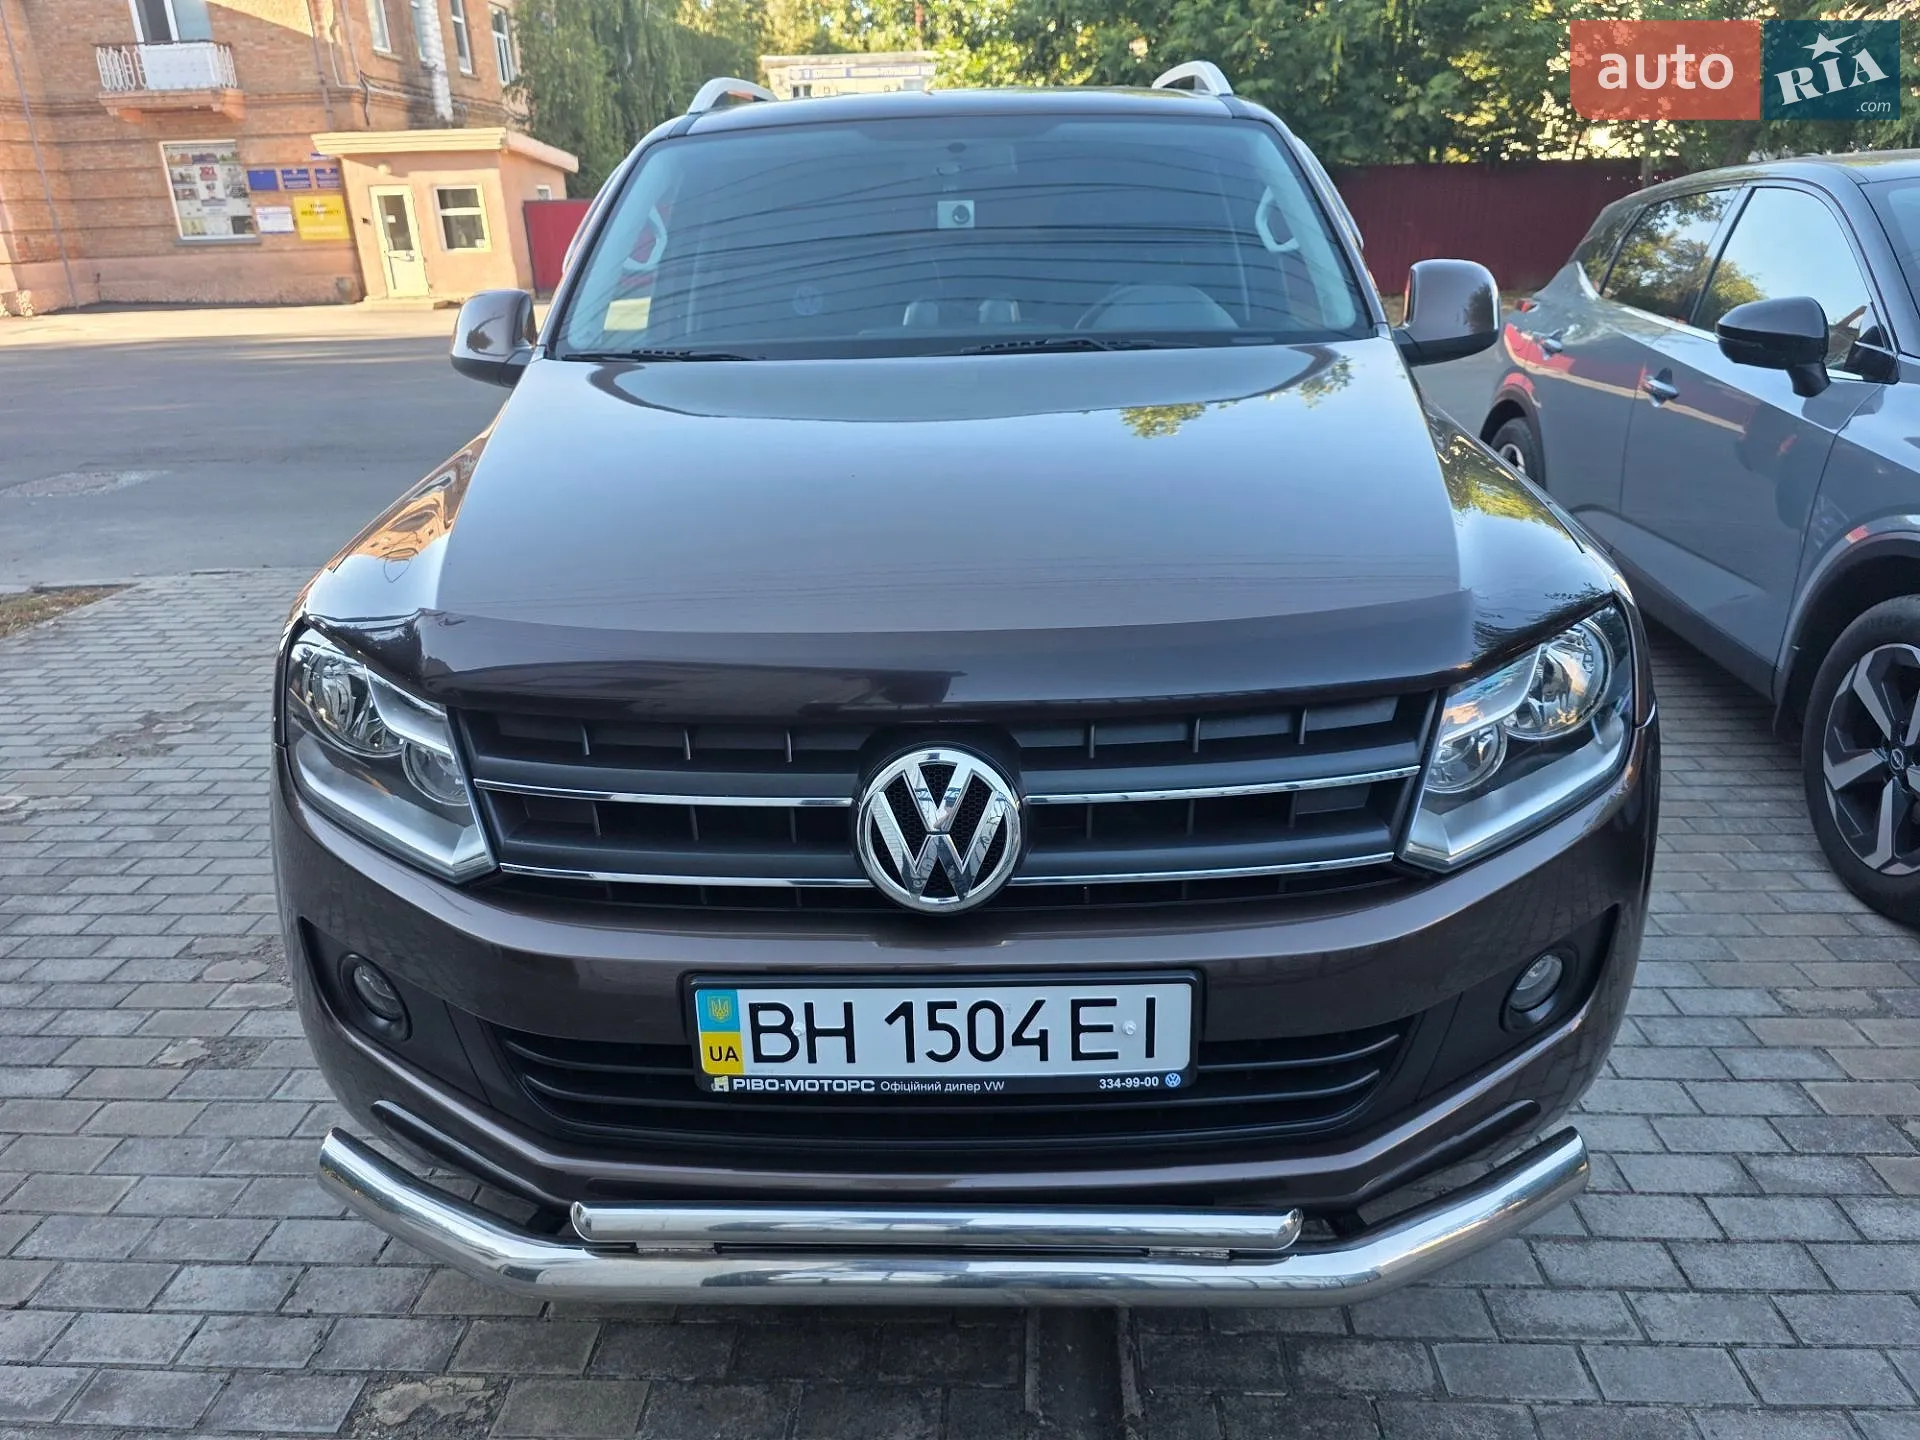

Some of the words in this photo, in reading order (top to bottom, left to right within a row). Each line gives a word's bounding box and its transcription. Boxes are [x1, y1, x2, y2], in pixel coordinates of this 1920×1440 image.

[884, 999, 1049, 1063] 1504
[709, 1046, 740, 1062] UA
[880, 1080, 942, 1093] Офіційний
[943, 1081, 981, 1094] дилер
[984, 1081, 1005, 1092] VW
[1099, 1076, 1160, 1090] 334-99-00
